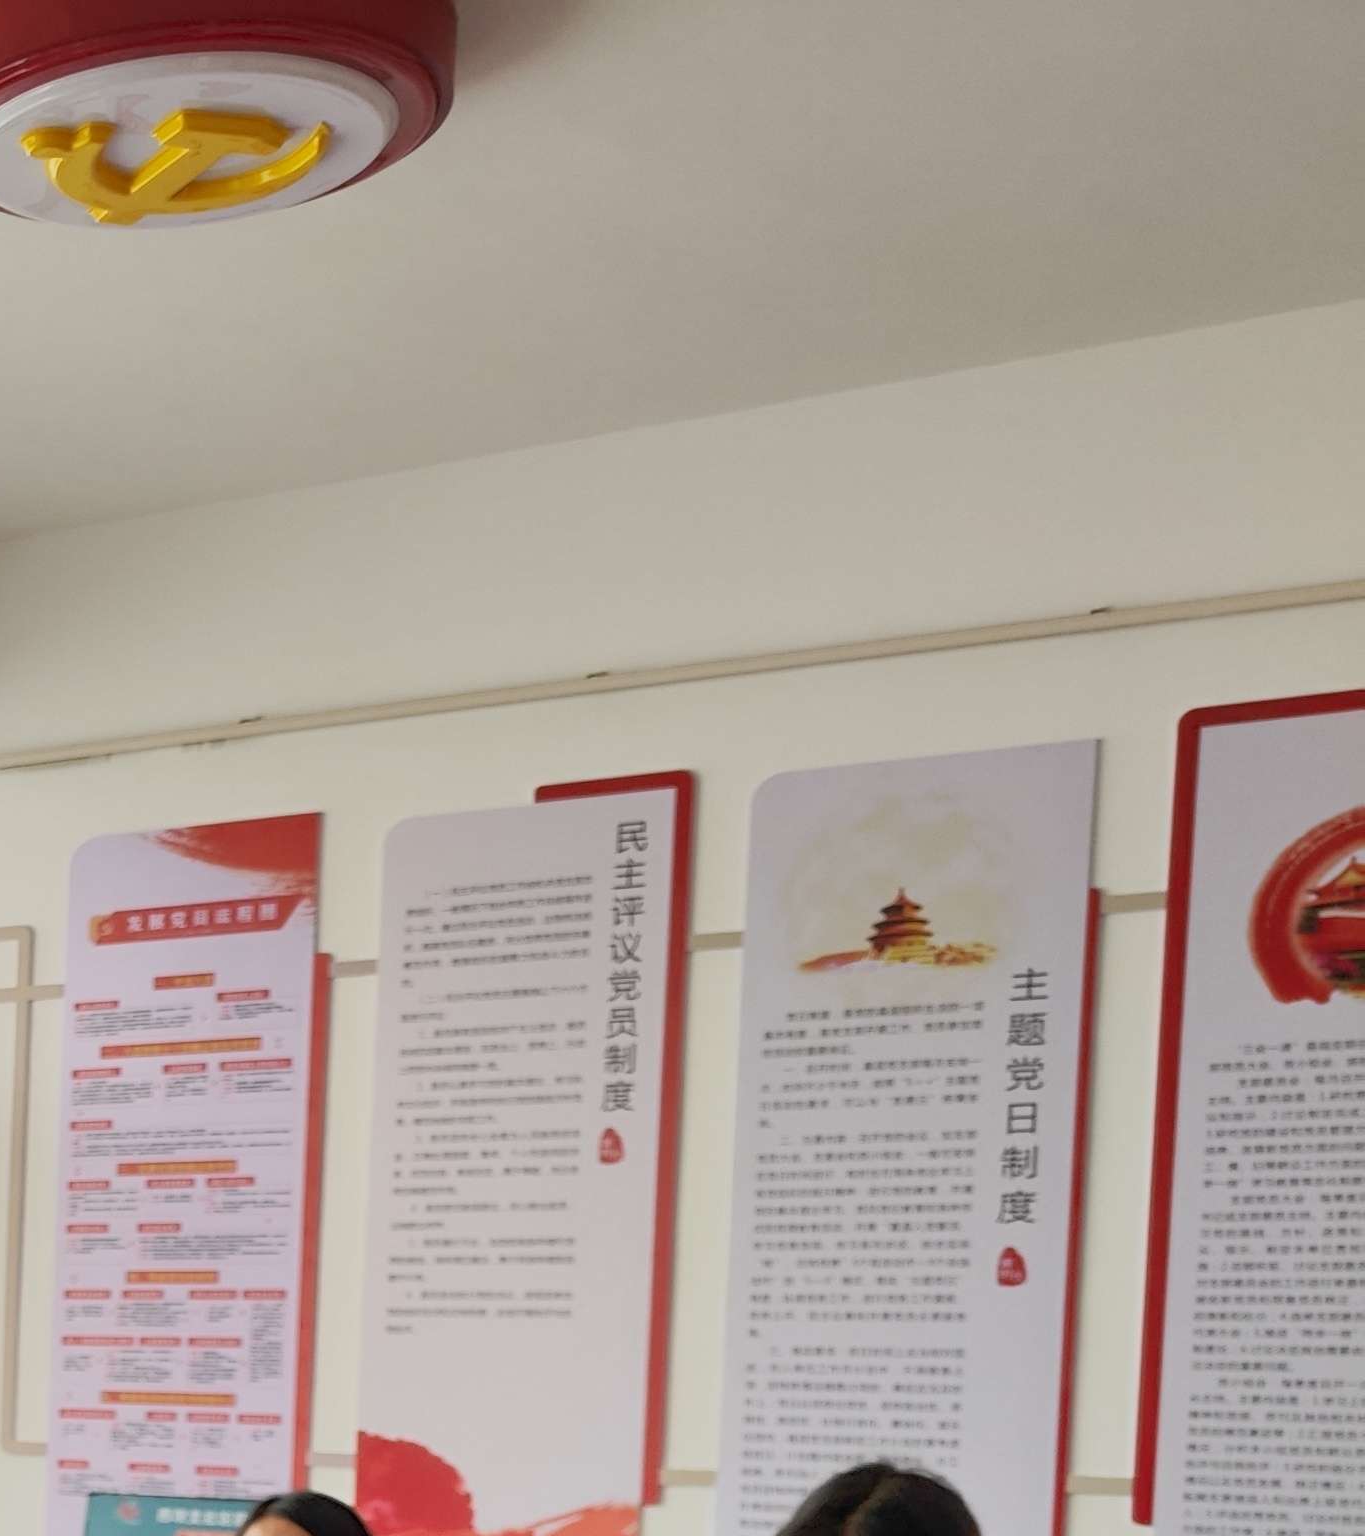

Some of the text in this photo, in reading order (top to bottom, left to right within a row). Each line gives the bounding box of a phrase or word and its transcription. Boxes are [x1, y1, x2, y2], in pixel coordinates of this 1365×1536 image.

[600, 819, 649, 1113] 民主评议党员制度
[996, 967, 1049, 1225] 主题党日制度
